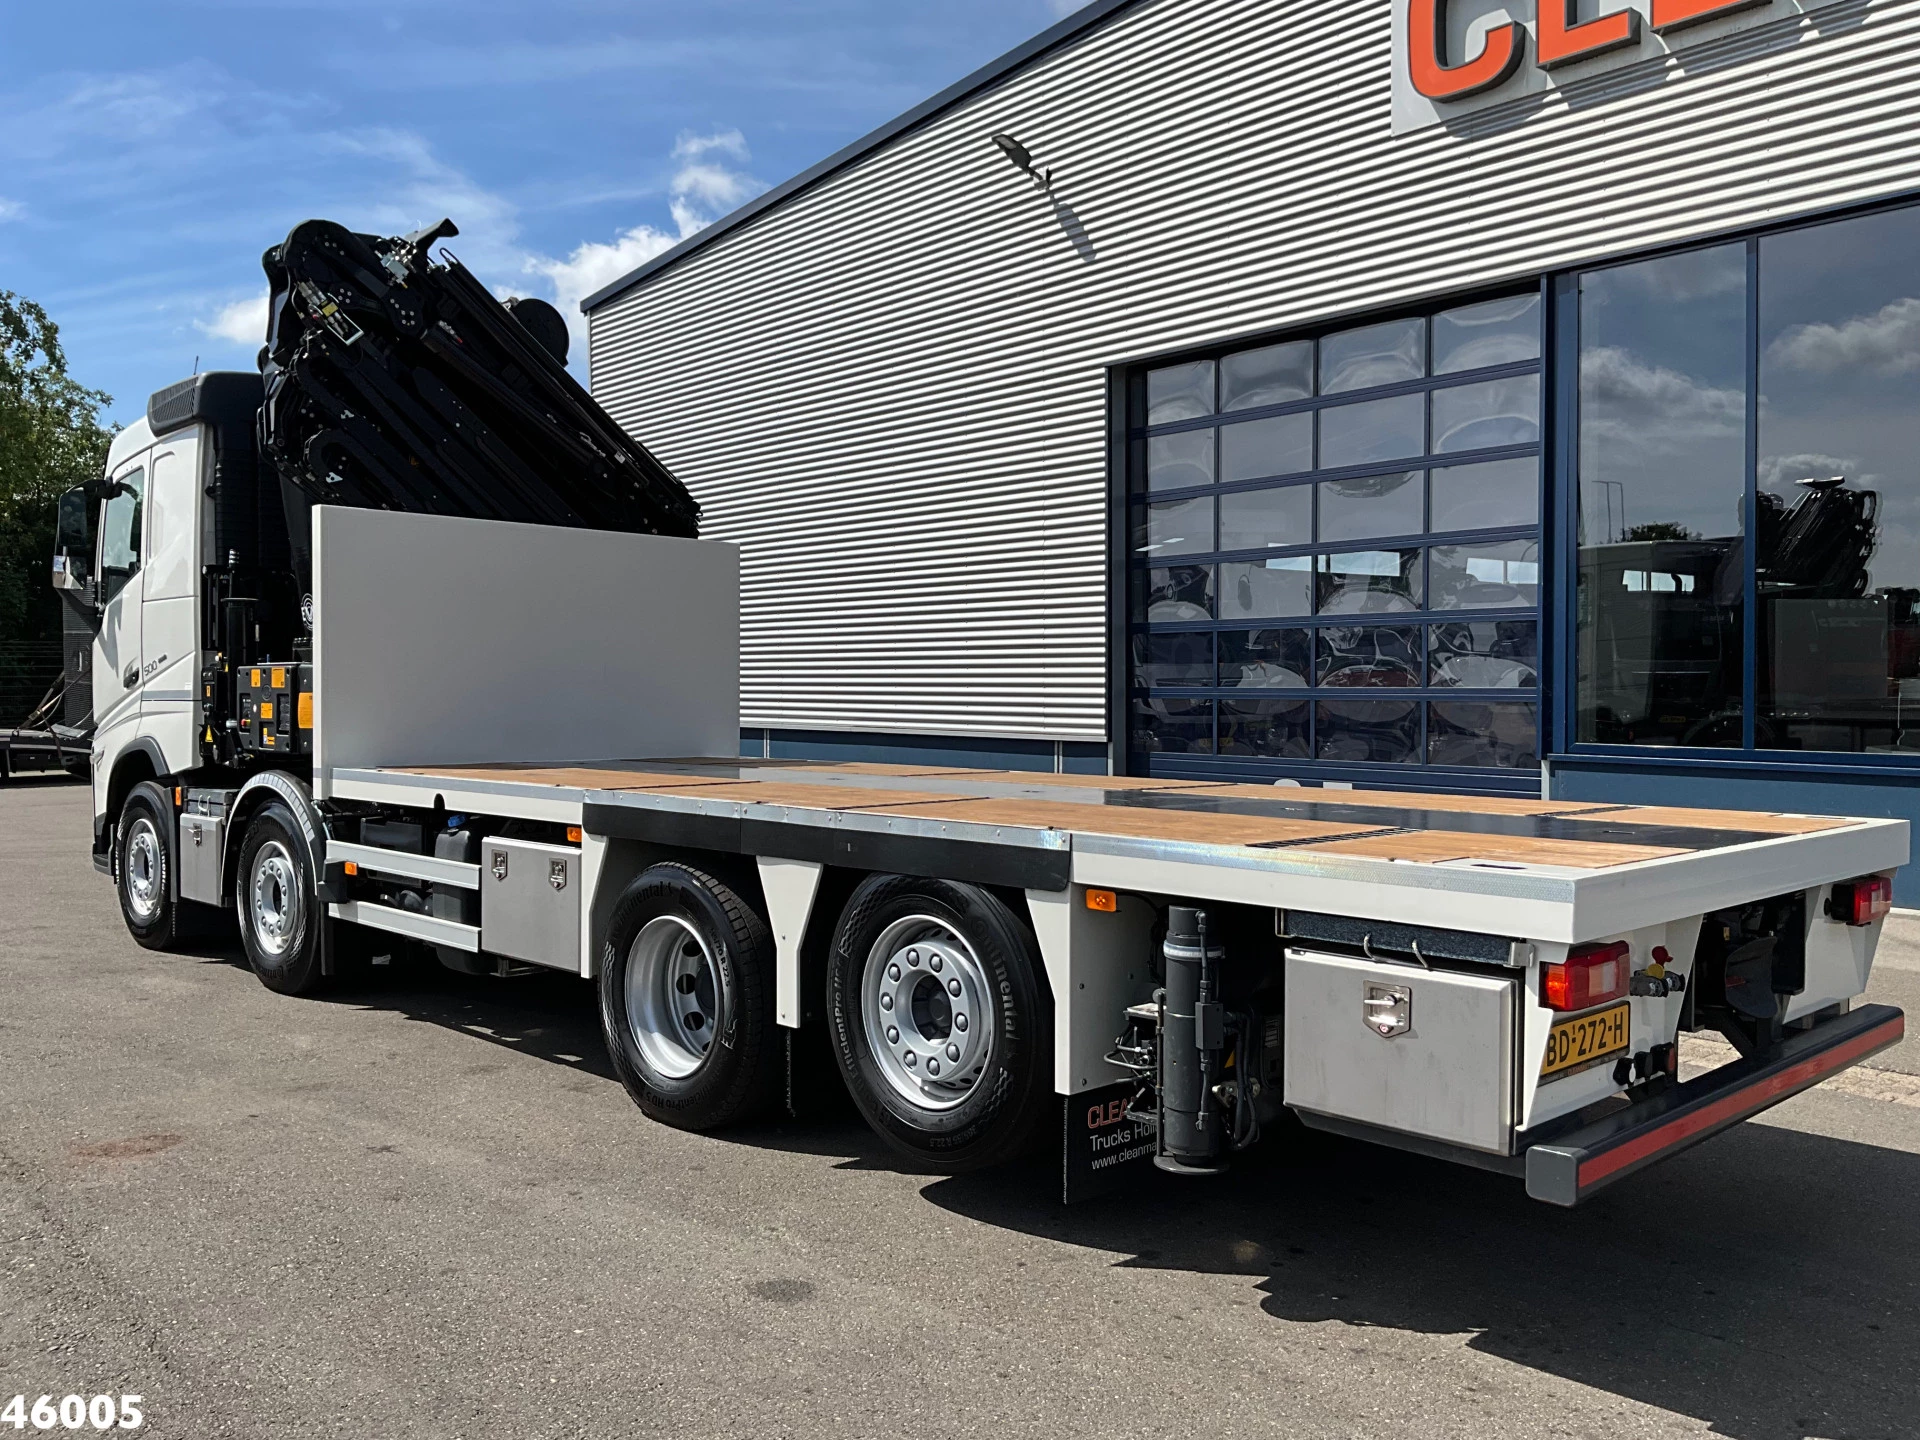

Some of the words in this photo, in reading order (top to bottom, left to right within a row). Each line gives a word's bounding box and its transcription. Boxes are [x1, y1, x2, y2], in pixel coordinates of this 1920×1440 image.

[144, 660, 158, 676] 500
[1087, 1096, 1135, 1129] CLEA
[1090, 1128, 1131, 1151] Trucks
[1134, 1121, 1157, 1140] Holl
[1092, 1141, 1157, 1170] www.cleanma
